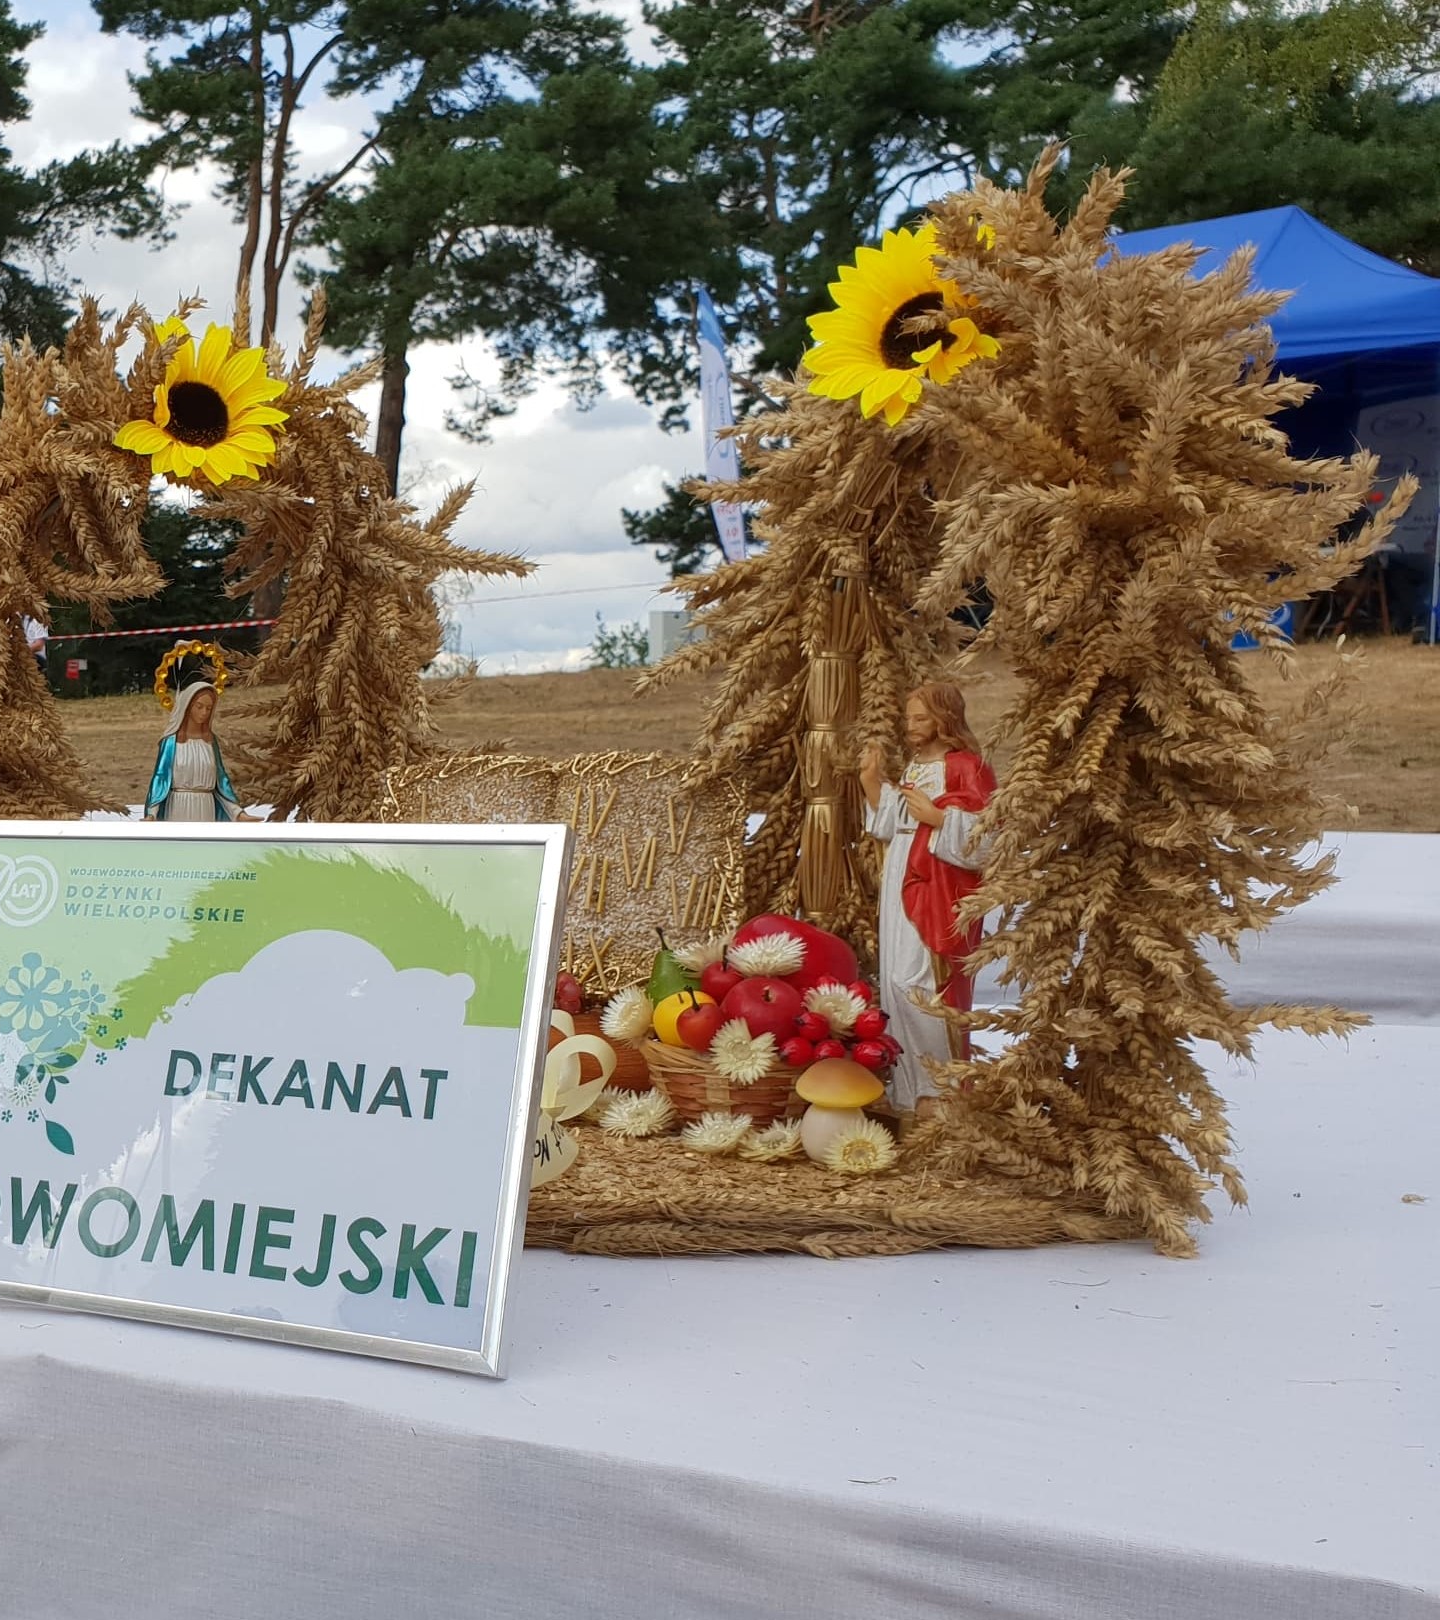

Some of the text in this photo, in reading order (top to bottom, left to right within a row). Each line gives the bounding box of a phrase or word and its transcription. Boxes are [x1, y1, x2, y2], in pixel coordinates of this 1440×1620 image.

[70, 868, 257, 881] WOJEWÓDZKO-ARCHIDIECEZJALNE
[11, 882, 40, 898] LAT
[66, 884, 162, 901] DOŻYNKI
[64, 902, 245, 922] WIELKOPOLSKIE
[163, 1049, 448, 1120] DEKANAT
